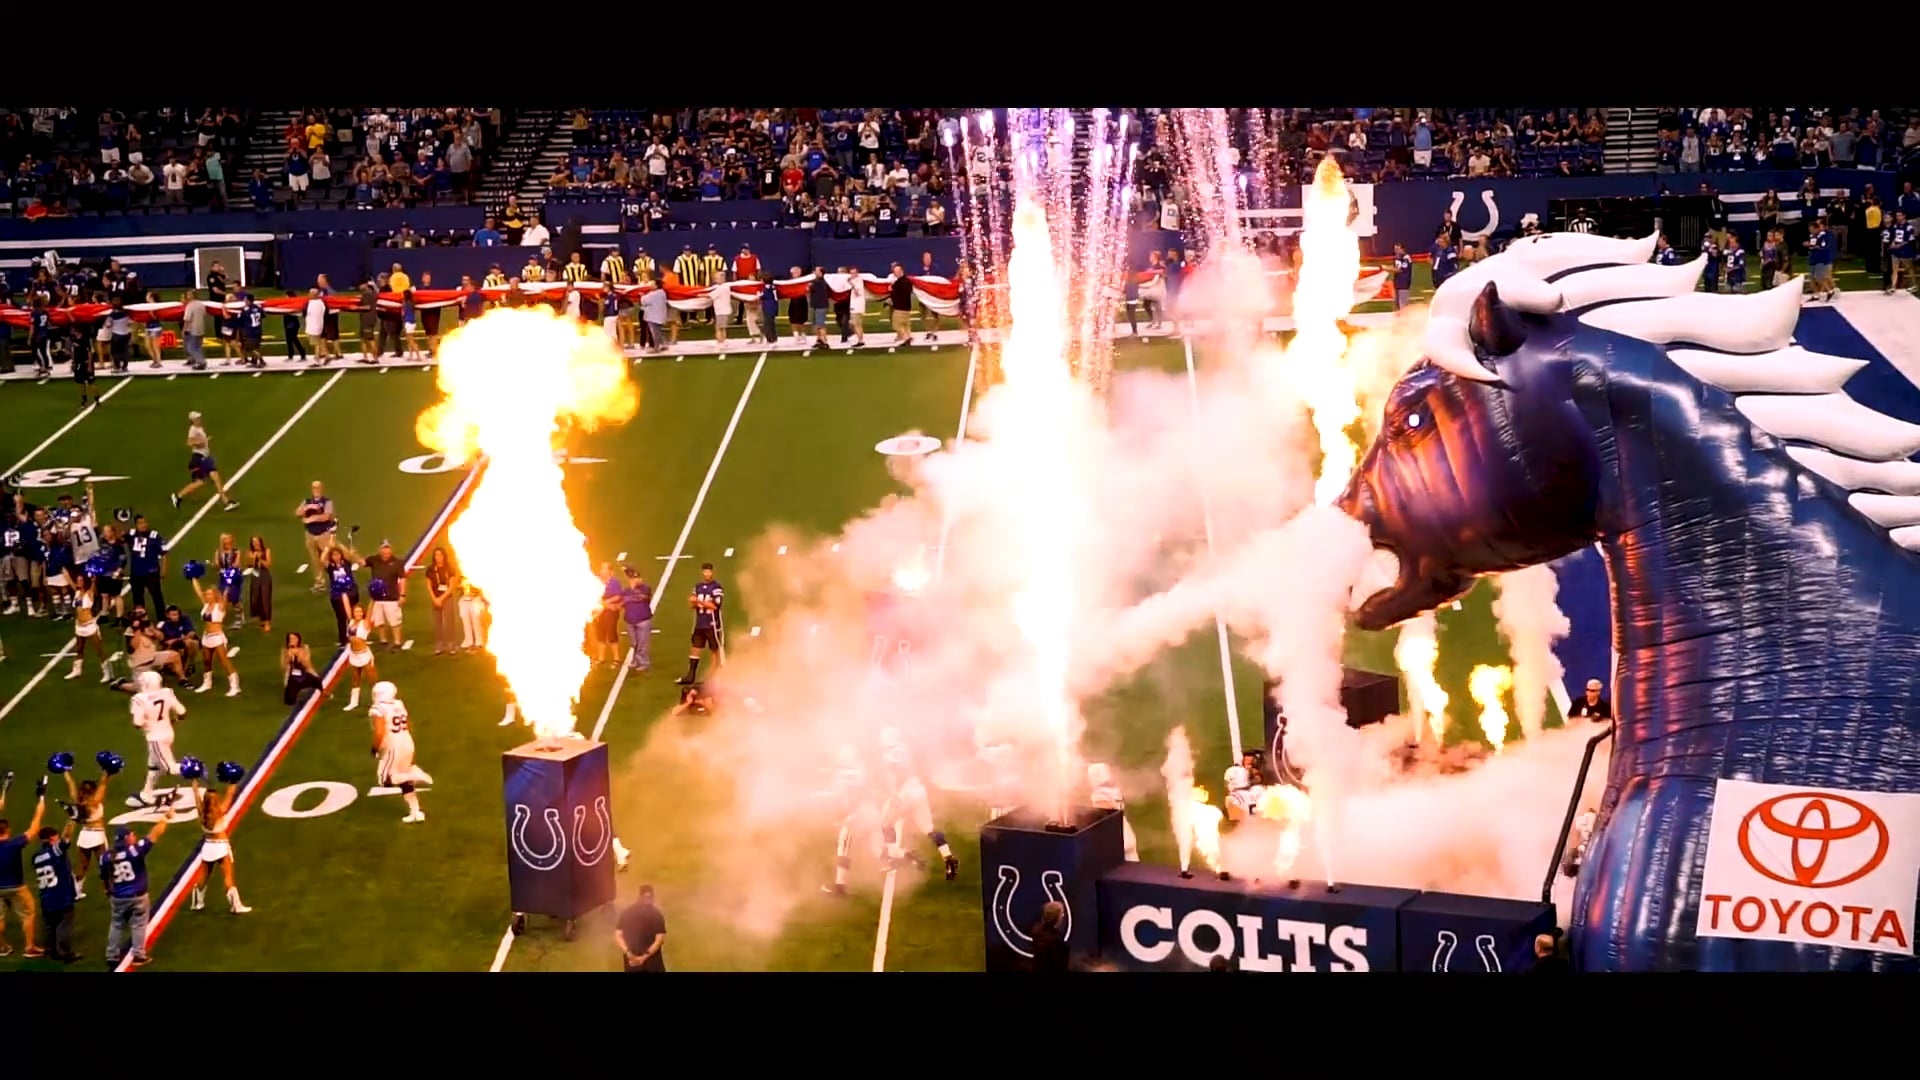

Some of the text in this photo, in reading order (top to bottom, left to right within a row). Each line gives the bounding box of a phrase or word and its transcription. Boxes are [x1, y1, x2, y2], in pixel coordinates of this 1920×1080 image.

[627, 204, 640, 216] 19
[879, 208, 891, 220] 12
[111, 281, 125, 292] 74
[249, 312, 262, 328] 12
[73, 526, 92, 546] 13
[152, 699, 165, 721] 7
[1704, 893, 1909, 948] TOYOTA
[1120, 904, 1370, 973] COLTS
